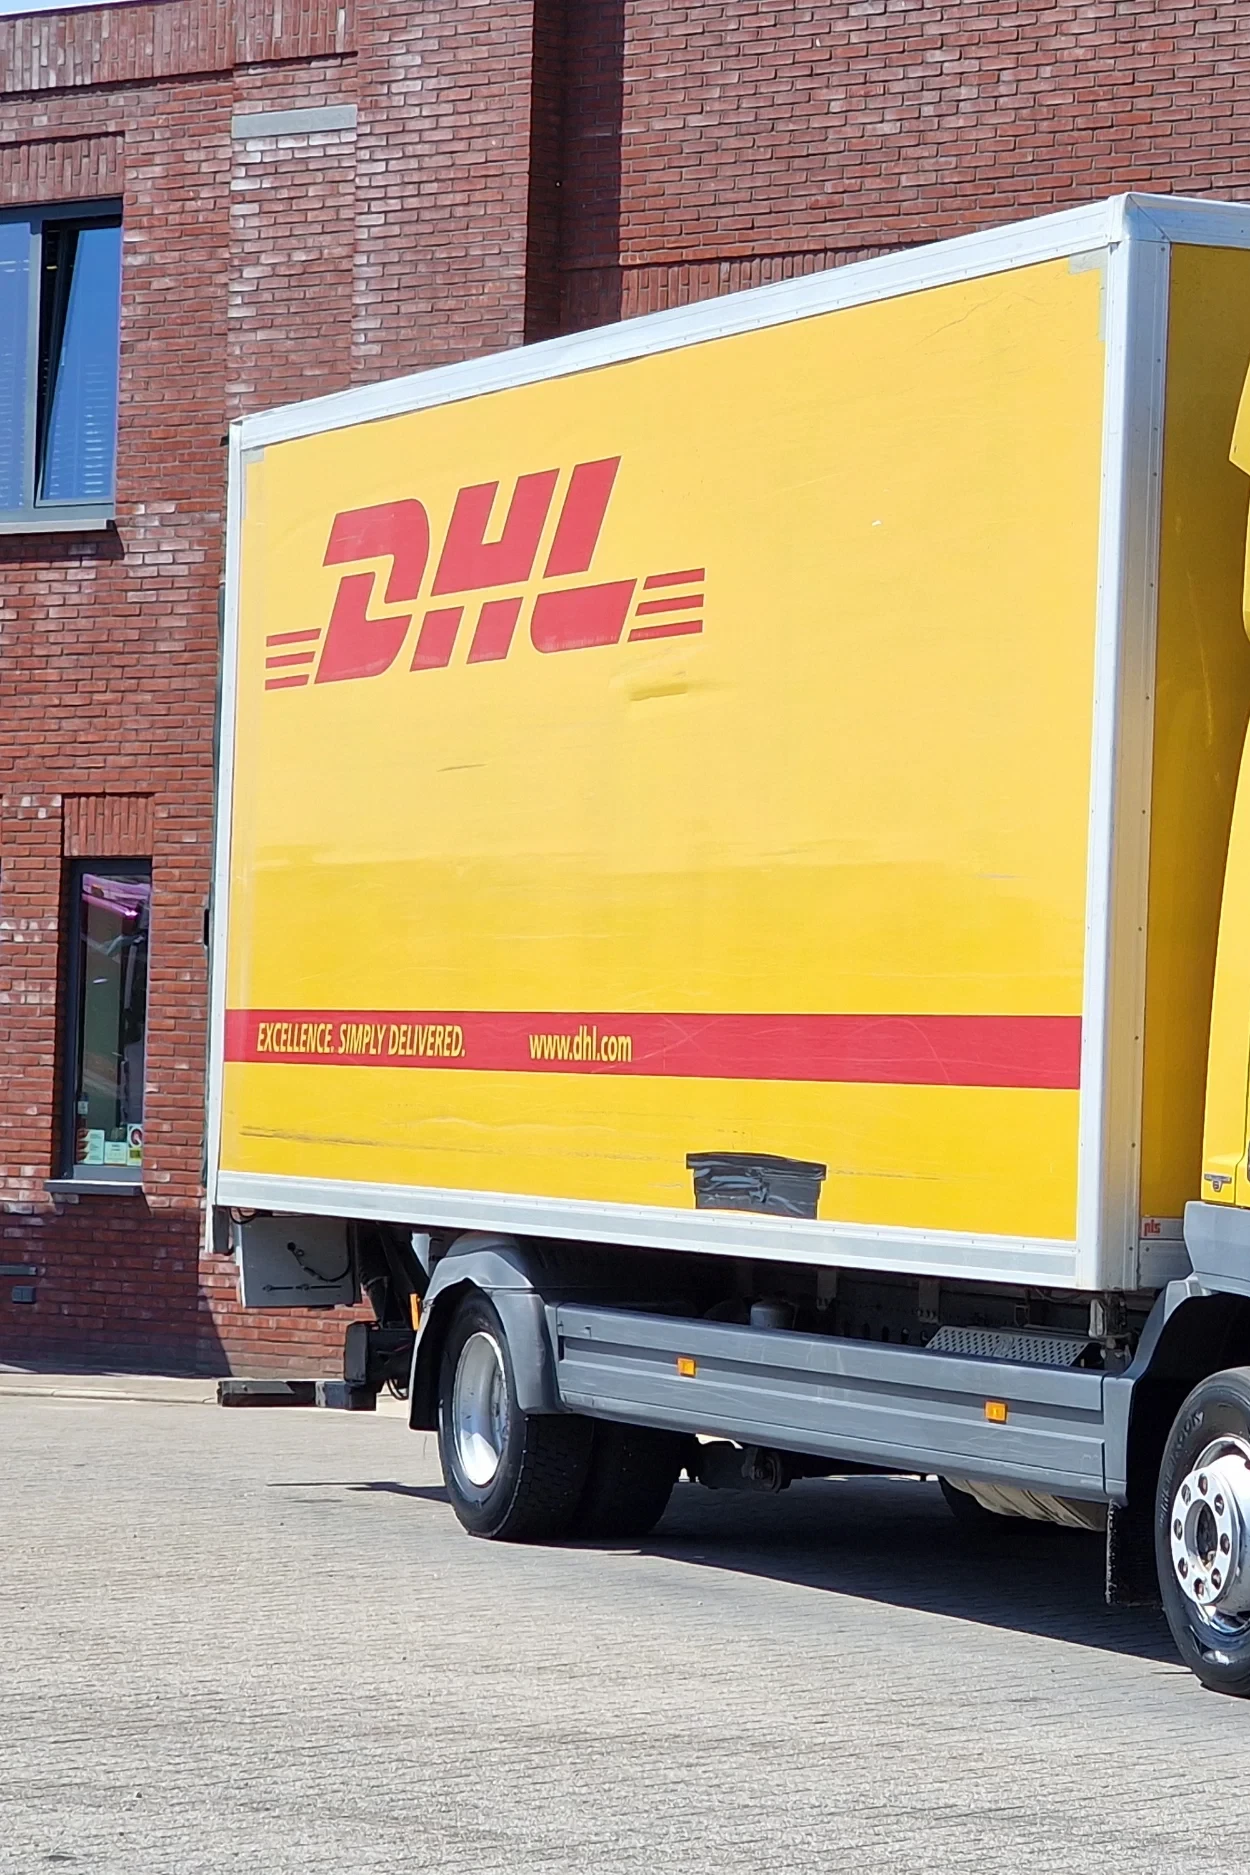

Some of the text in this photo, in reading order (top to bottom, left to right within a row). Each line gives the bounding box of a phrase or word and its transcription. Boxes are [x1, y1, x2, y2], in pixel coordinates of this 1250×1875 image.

[314, 456, 638, 685] DHL
[257, 1022, 466, 1058] EXCELLENCE. SIMPLY DELIVERED.
[529, 1026, 633, 1063] www.dhl.com
